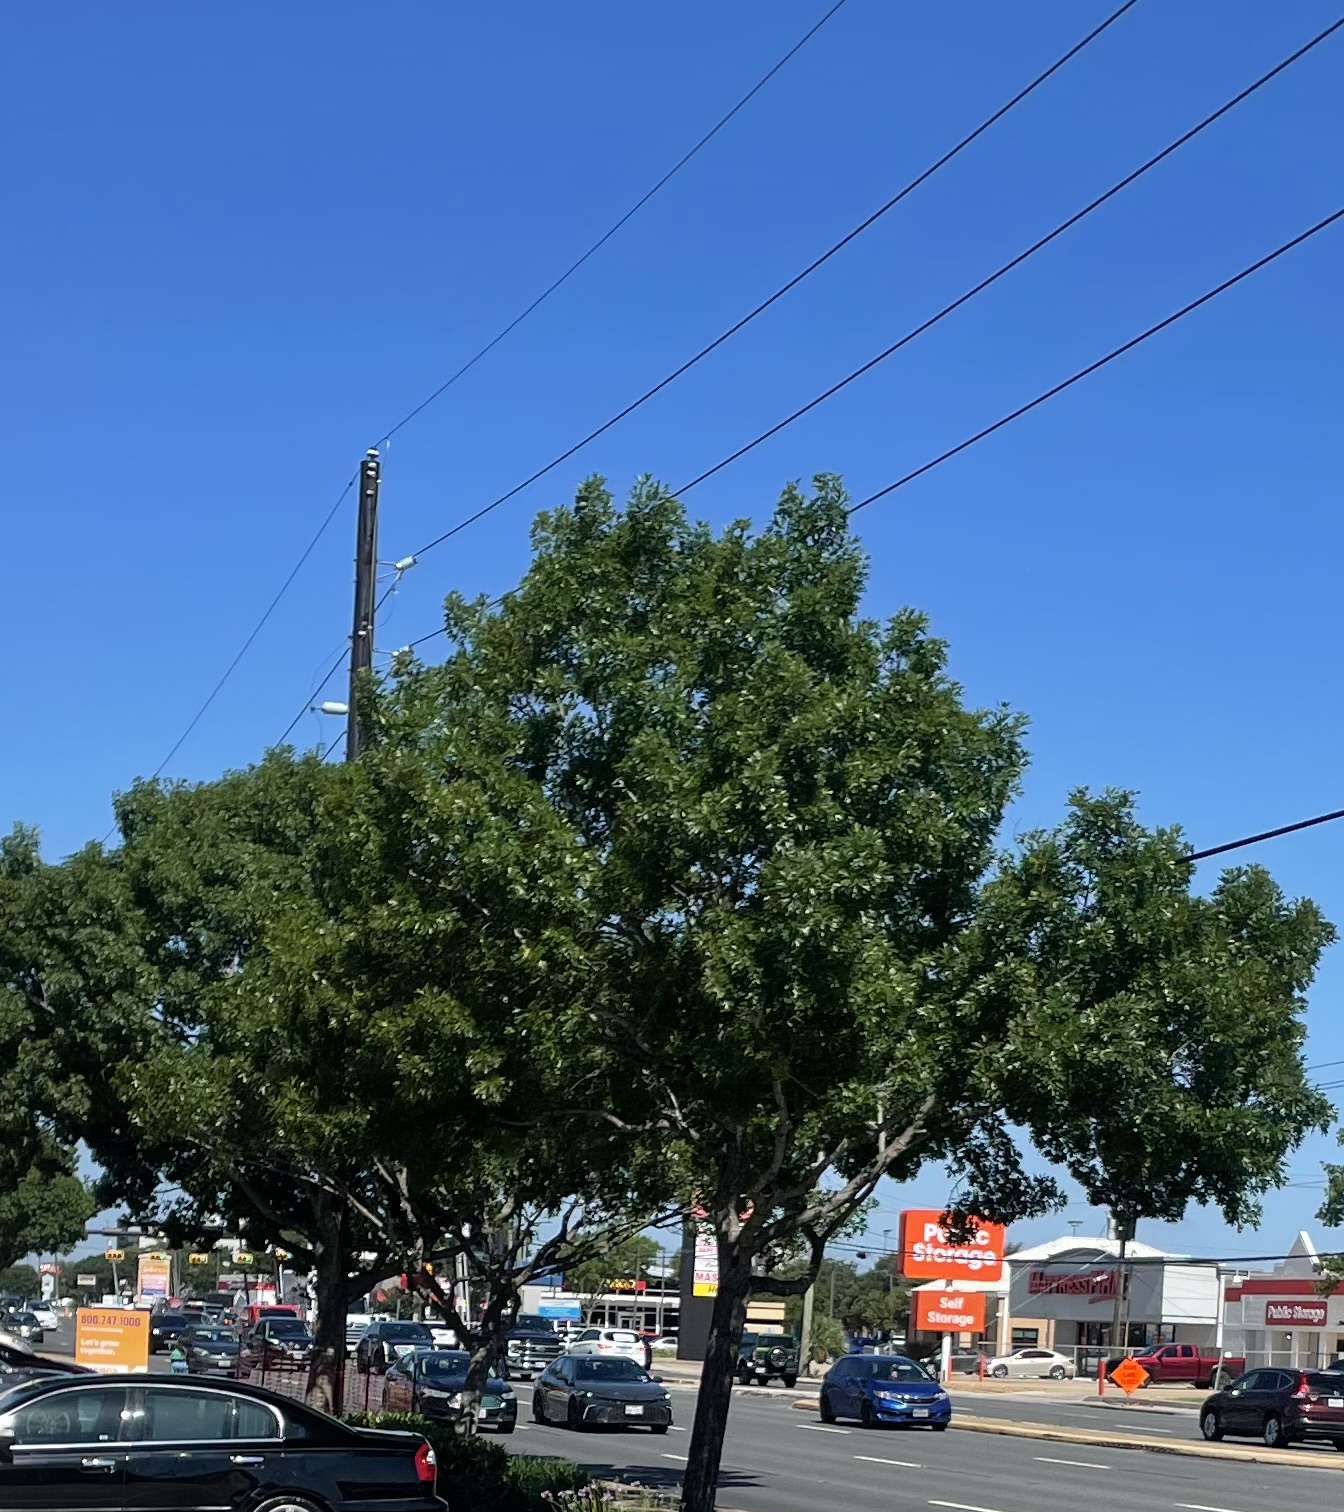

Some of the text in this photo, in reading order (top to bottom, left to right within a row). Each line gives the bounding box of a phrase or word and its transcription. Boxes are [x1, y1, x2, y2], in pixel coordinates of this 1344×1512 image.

[912, 1242, 997, 1270] Storage
[939, 1296, 965, 1310] Self
[927, 1311, 974, 1327] Storage
